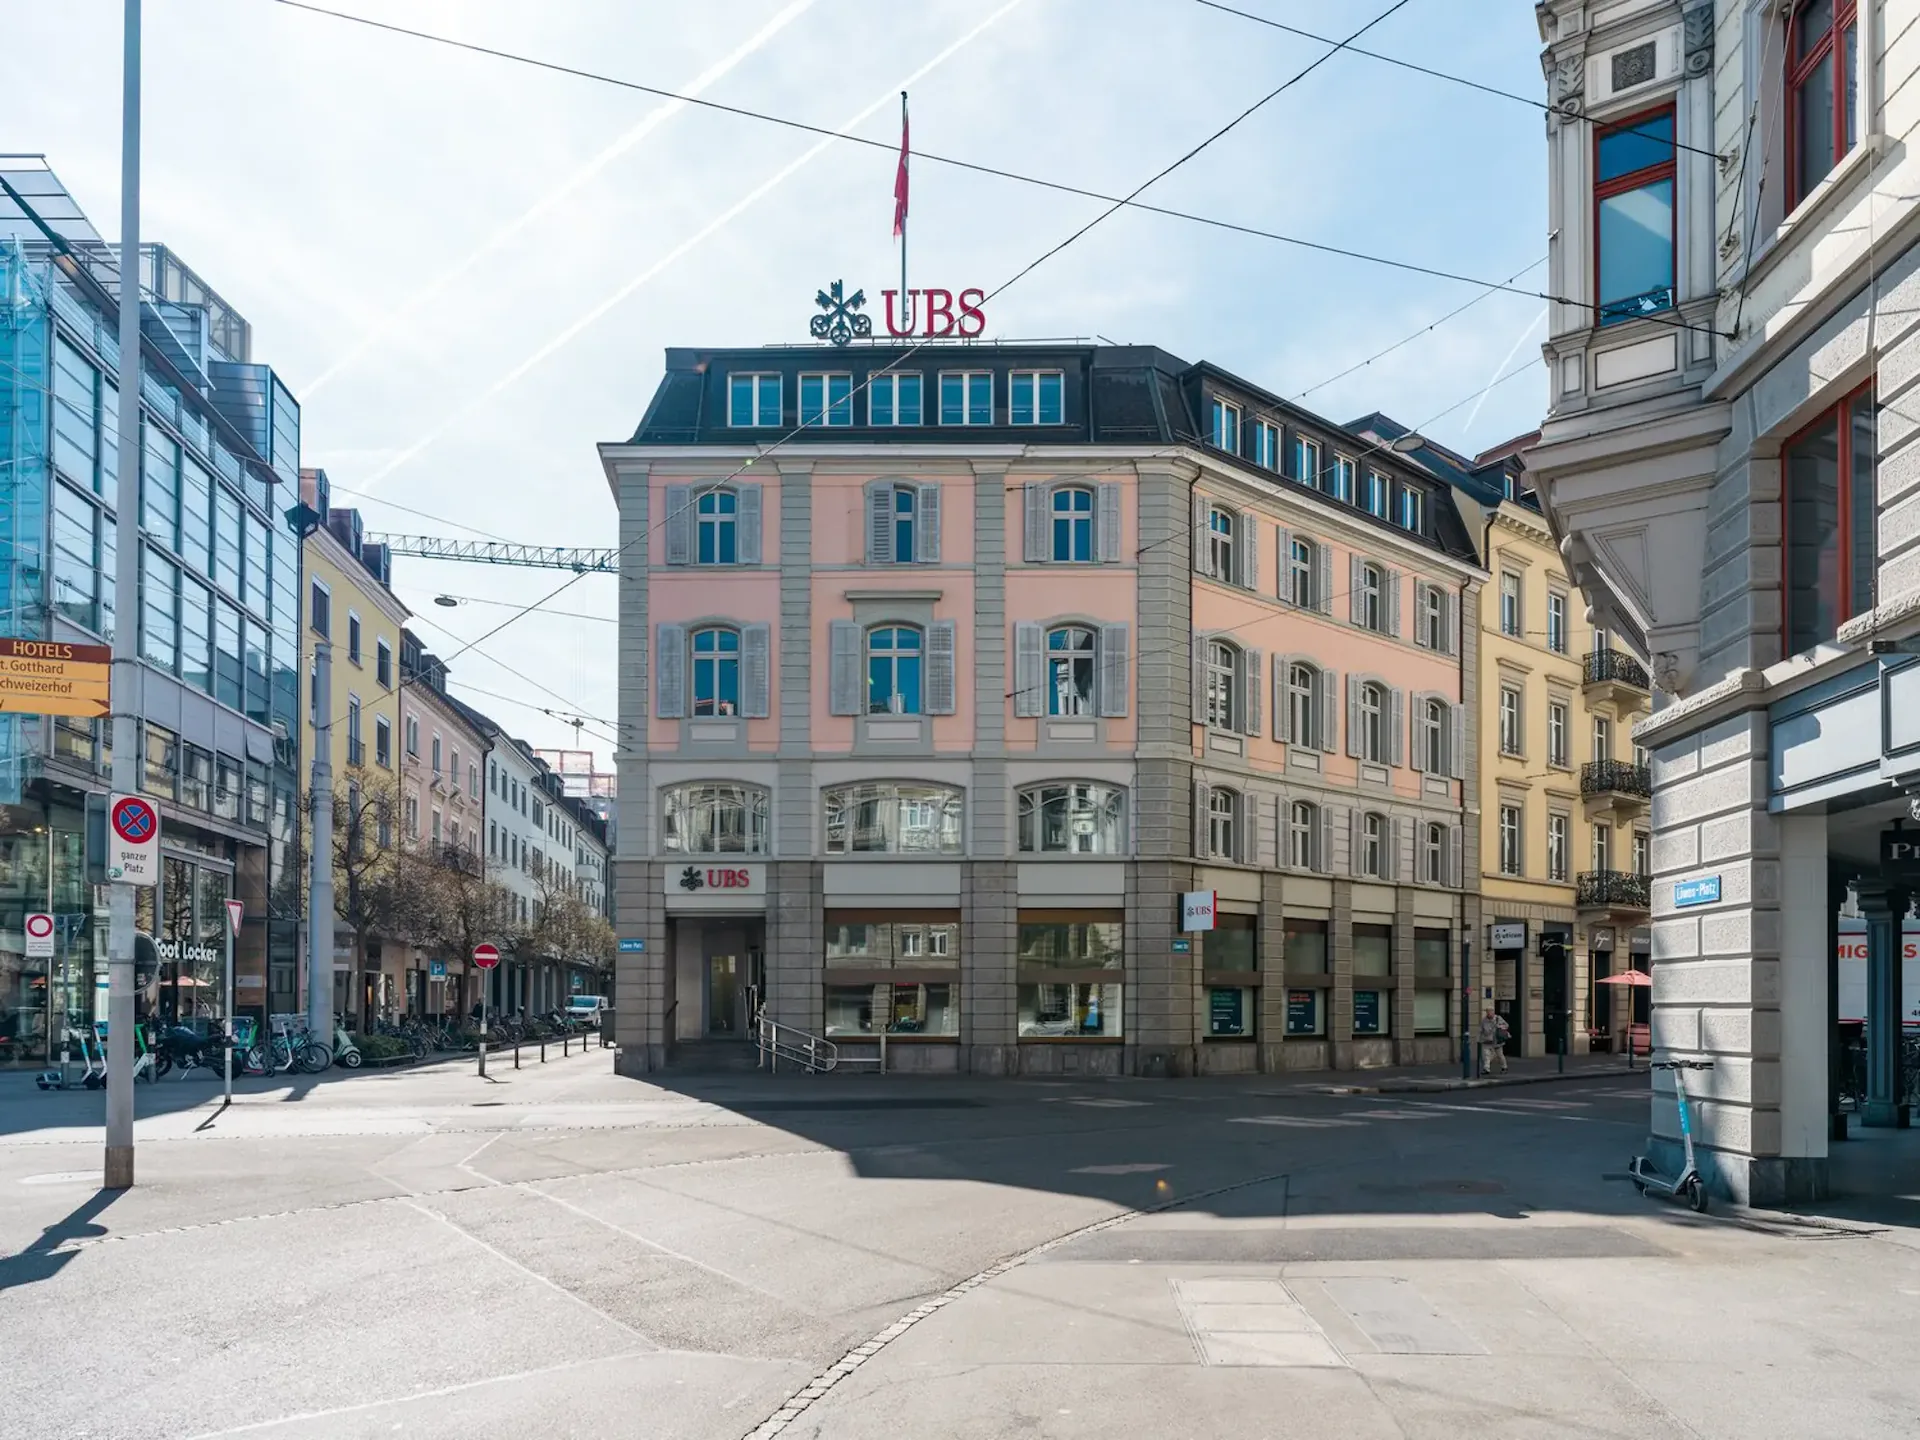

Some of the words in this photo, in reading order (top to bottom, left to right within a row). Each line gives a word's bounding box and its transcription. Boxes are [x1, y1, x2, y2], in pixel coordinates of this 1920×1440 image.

[881, 288, 986, 337] UBS
[13, 641, 72, 659] HOTELS
[0, 660, 8, 670] t.
[10, 660, 64, 674] Gotthard
[0, 677, 73, 693] chweizerhof
[121, 852, 147, 861] ganzer
[124, 862, 144, 874] Platz
[707, 869, 750, 888] UBS
[1195, 905, 1212, 915] UBS
[183, 941, 217, 962] Locker
